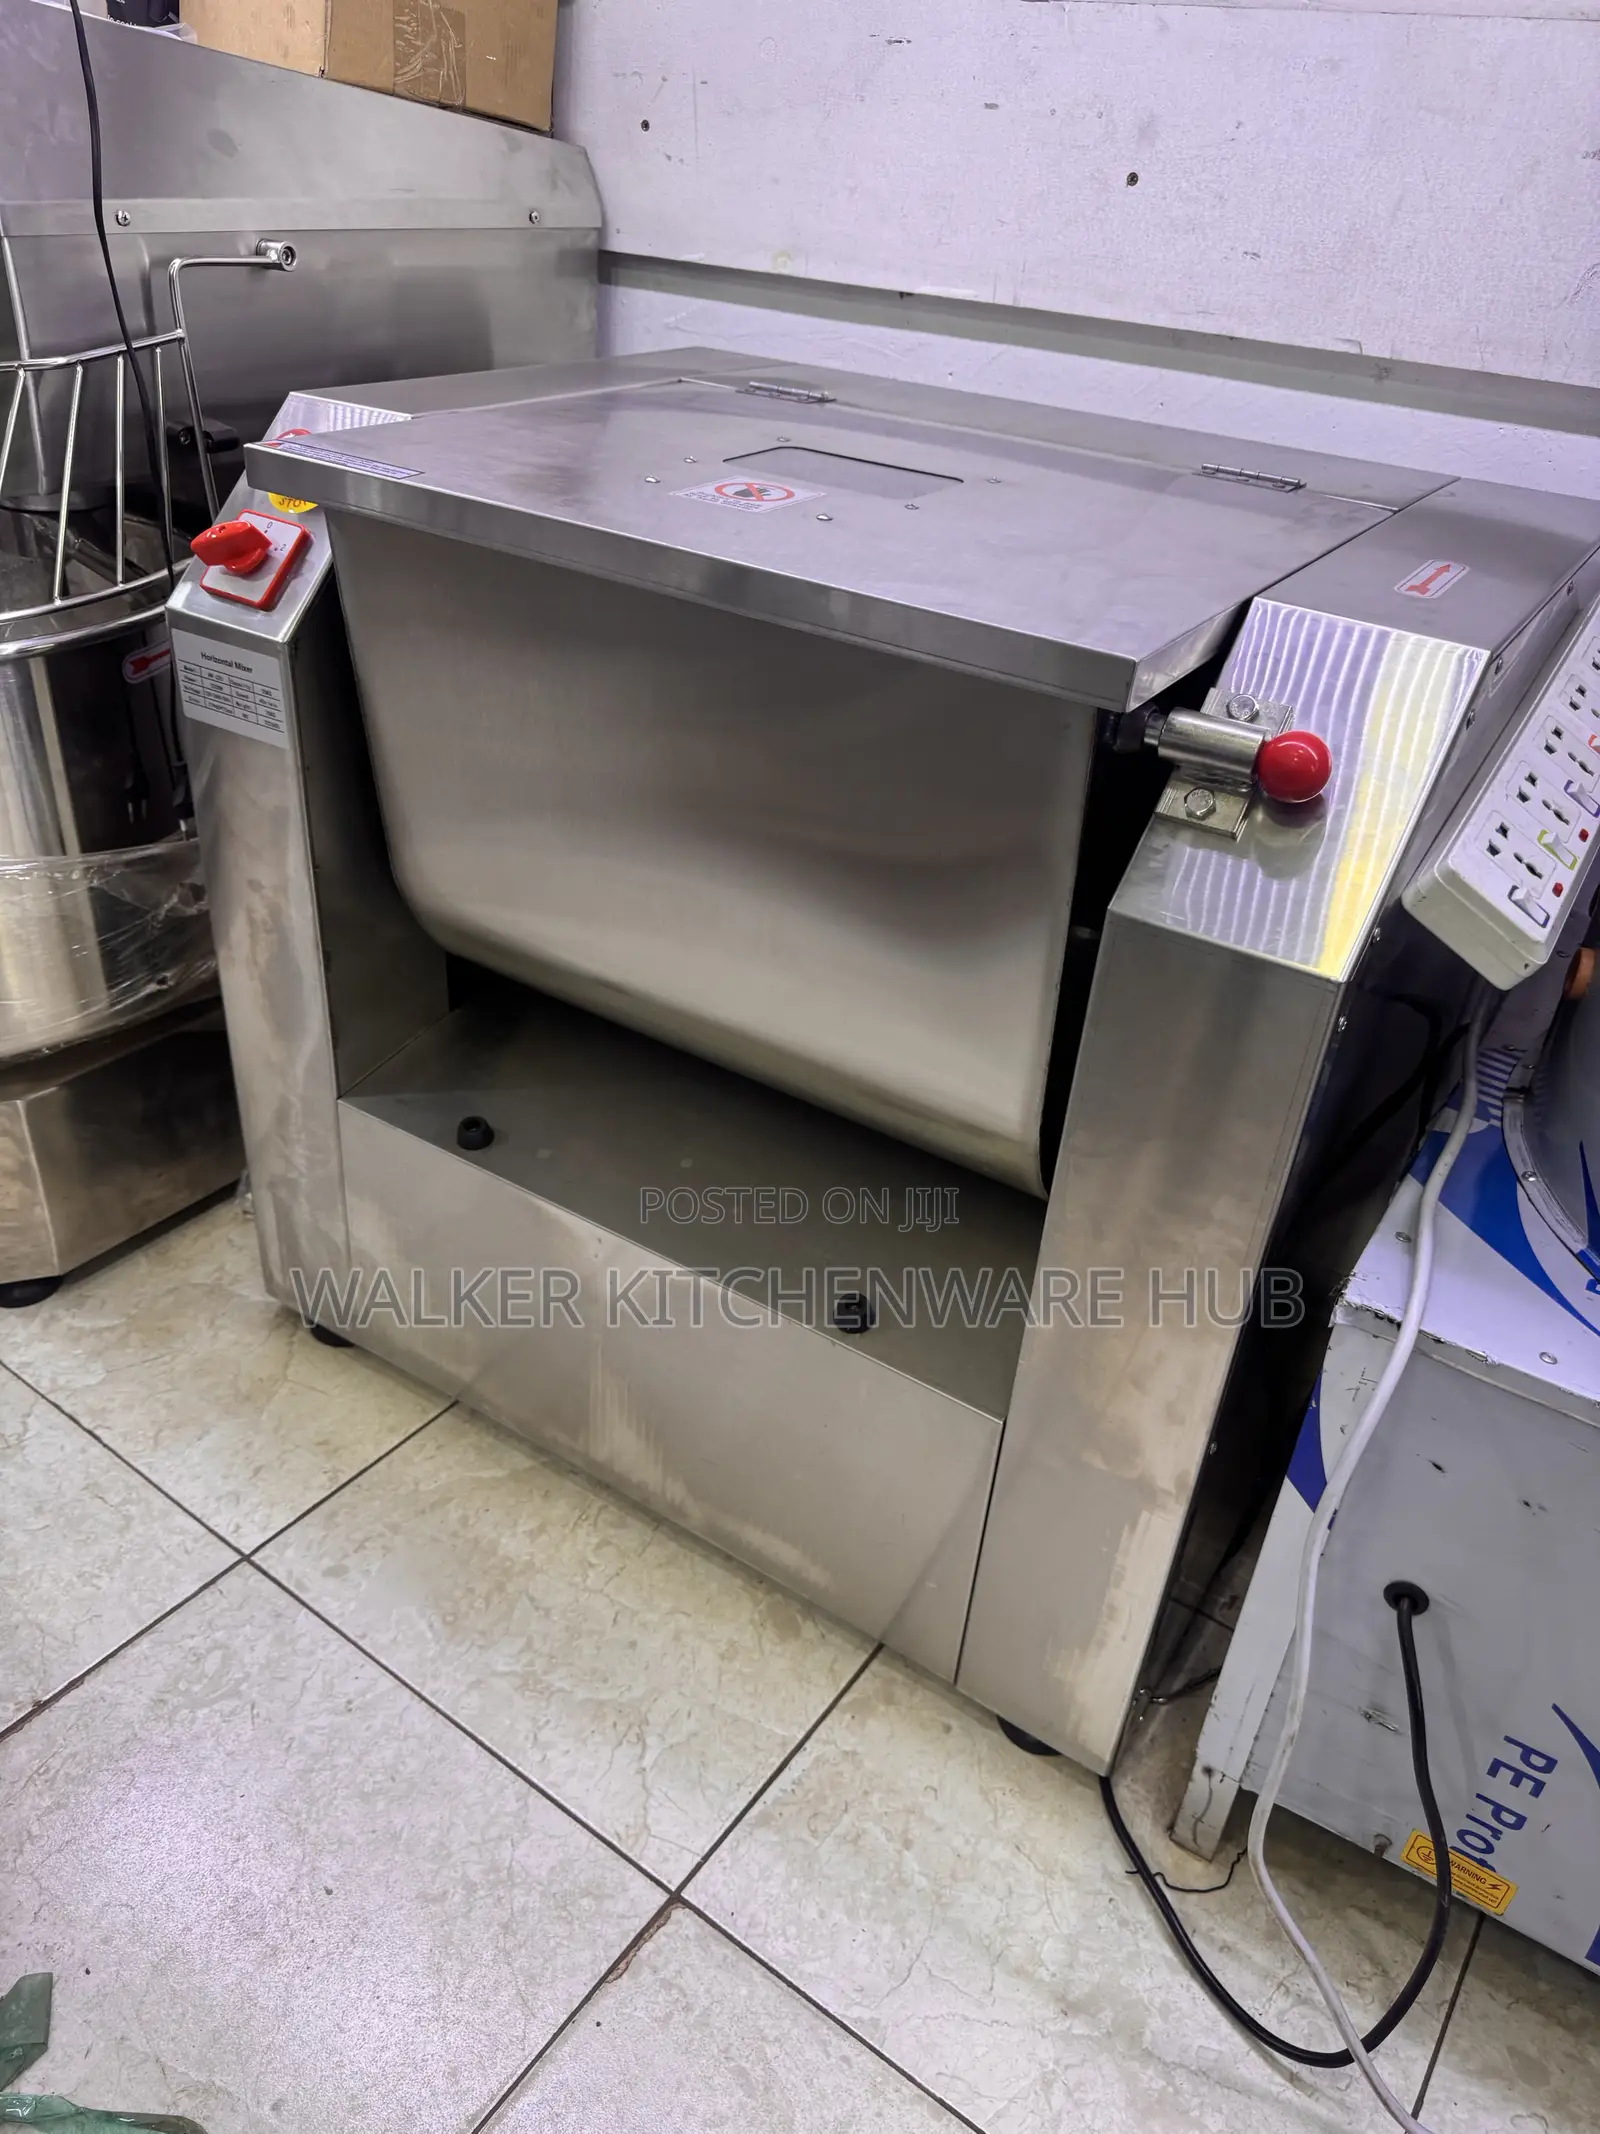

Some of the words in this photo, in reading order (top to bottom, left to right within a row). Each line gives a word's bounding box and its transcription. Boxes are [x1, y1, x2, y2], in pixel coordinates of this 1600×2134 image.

[279, 543, 287, 552] 2
[201, 652, 234, 668] Horizontal
[235, 661, 253, 674] Mixer
[1486, 1734, 1559, 1799] PE
